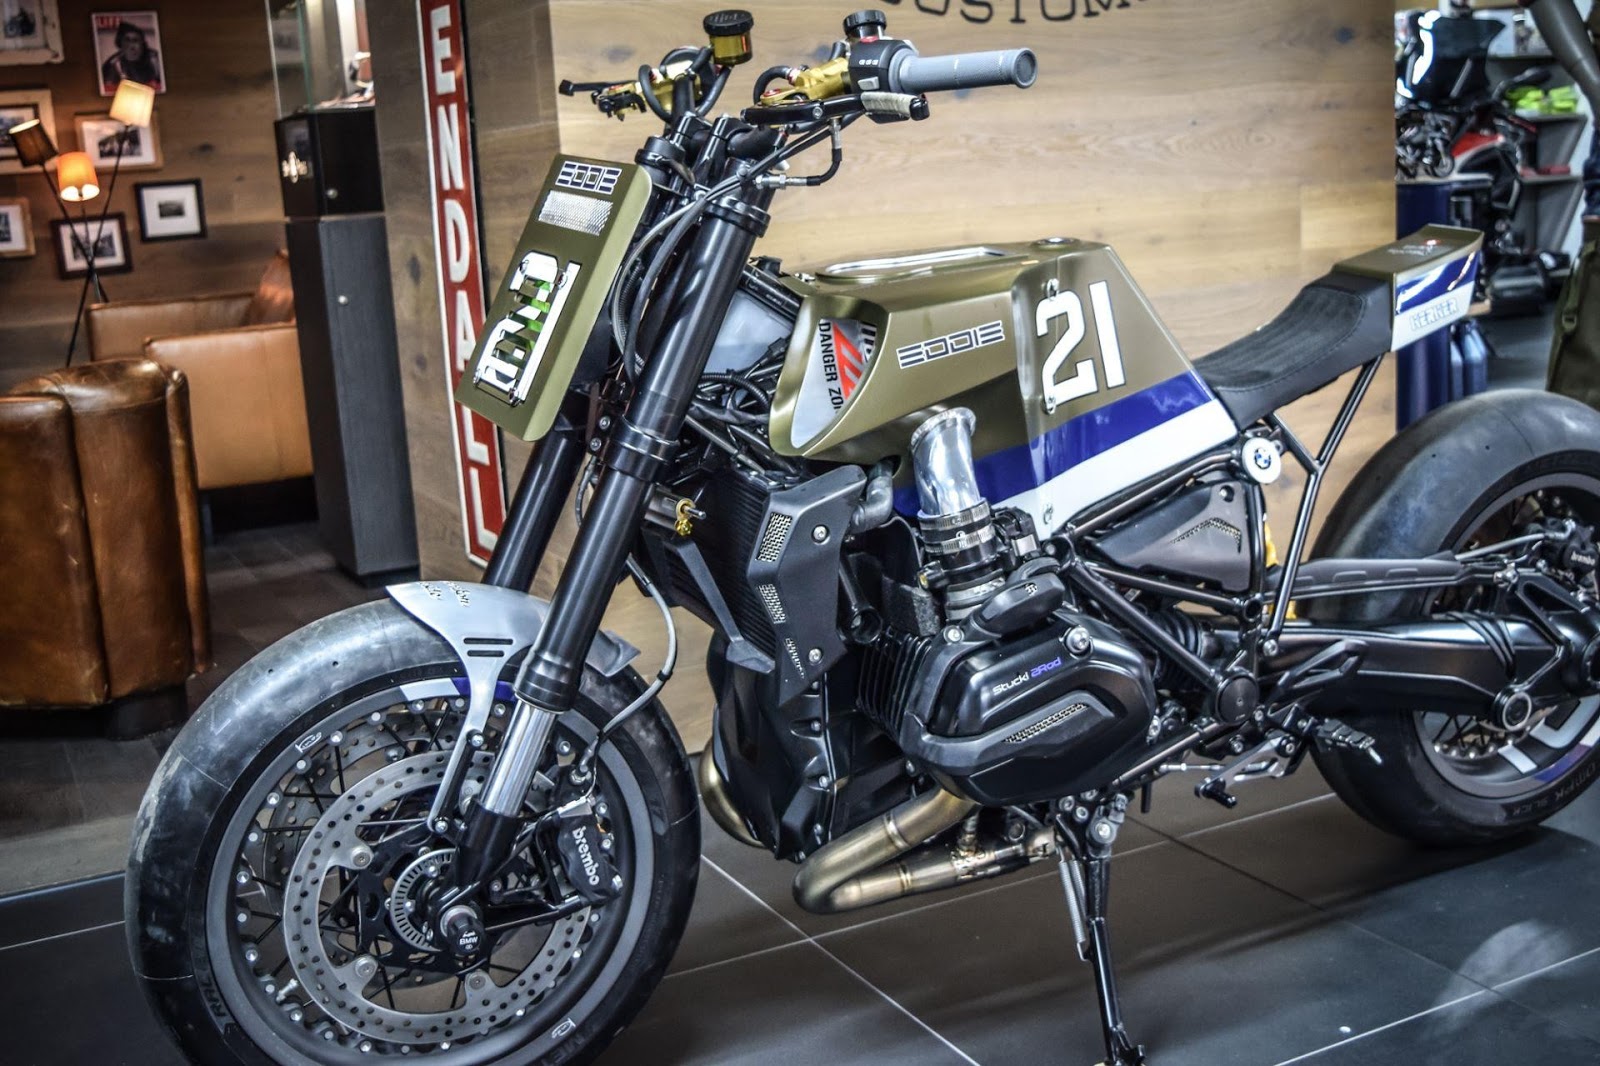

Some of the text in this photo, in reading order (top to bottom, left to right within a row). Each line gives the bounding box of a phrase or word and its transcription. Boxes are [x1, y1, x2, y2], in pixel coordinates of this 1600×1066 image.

[555, 161, 622, 195] EDDIE
[818, 322, 839, 382] DANGER
[896, 320, 1005, 369] EDDIE
[1036, 279, 1126, 412] 21
[572, 826, 600, 885] brembo
[459, 936, 478, 945] BMW
